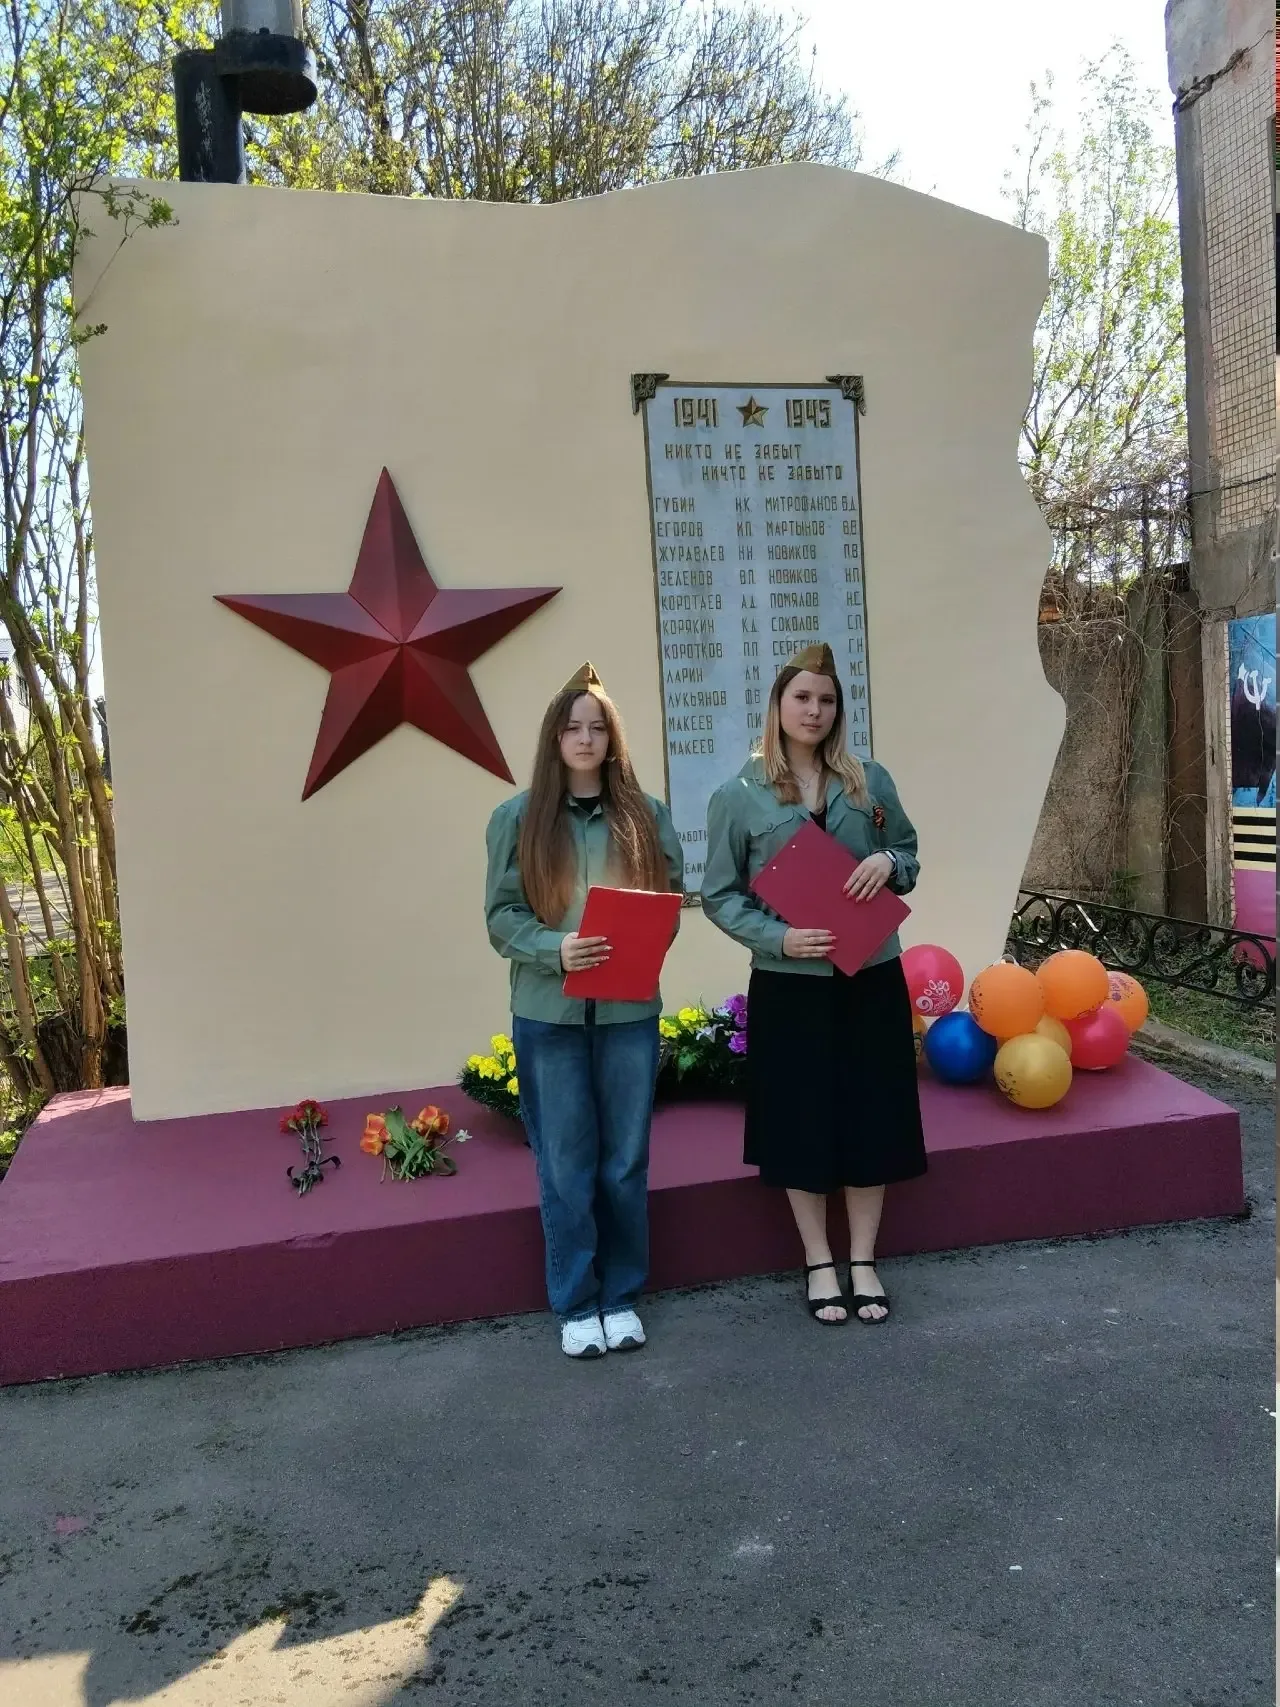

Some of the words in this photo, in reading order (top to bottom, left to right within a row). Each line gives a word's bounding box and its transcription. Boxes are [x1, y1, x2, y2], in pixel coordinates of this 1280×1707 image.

[674, 398, 719, 427] 1941
[786, 399, 832, 428] 1945
[665, 444, 711, 460] НИКТО
[725, 444, 741, 460] НЕ
[754, 444, 801, 460] ЗАБЫТ
[702, 466, 745, 481] НИЧТО
[759, 466, 774, 481] НЕ
[788, 465, 842, 480] ЗАБЫТО
[656, 497, 694, 512] ГУБИН
[766, 496, 837, 512] МИТРОФАНОВ
[657, 522, 703, 536] ЕГОРОВ
[766, 521, 824, 536] МАРТЫНОВ
[659, 546, 724, 563] ЖУРАВЛЕВ
[768, 545, 816, 560] НОВИКОВ
[661, 570, 712, 586] ЗЕЛЕНОВ
[769, 569, 817, 584] НОВИКОВ
[662, 594, 721, 610] КОРОТАЕВ
[770, 592, 818, 608] ПОМЯЛОВ
[663, 619, 714, 634] КОРЯКИН
[772, 616, 819, 631] СОКОЛОВ
[664, 643, 722, 660] КОРОТКОВ
[667, 668, 702, 683] ЛАРИН
[668, 691, 726, 708] ЛУКЬЯНОВ
[669, 715, 712, 732] МАКЕЕВ
[670, 739, 714, 756] МАКЕЕВ
